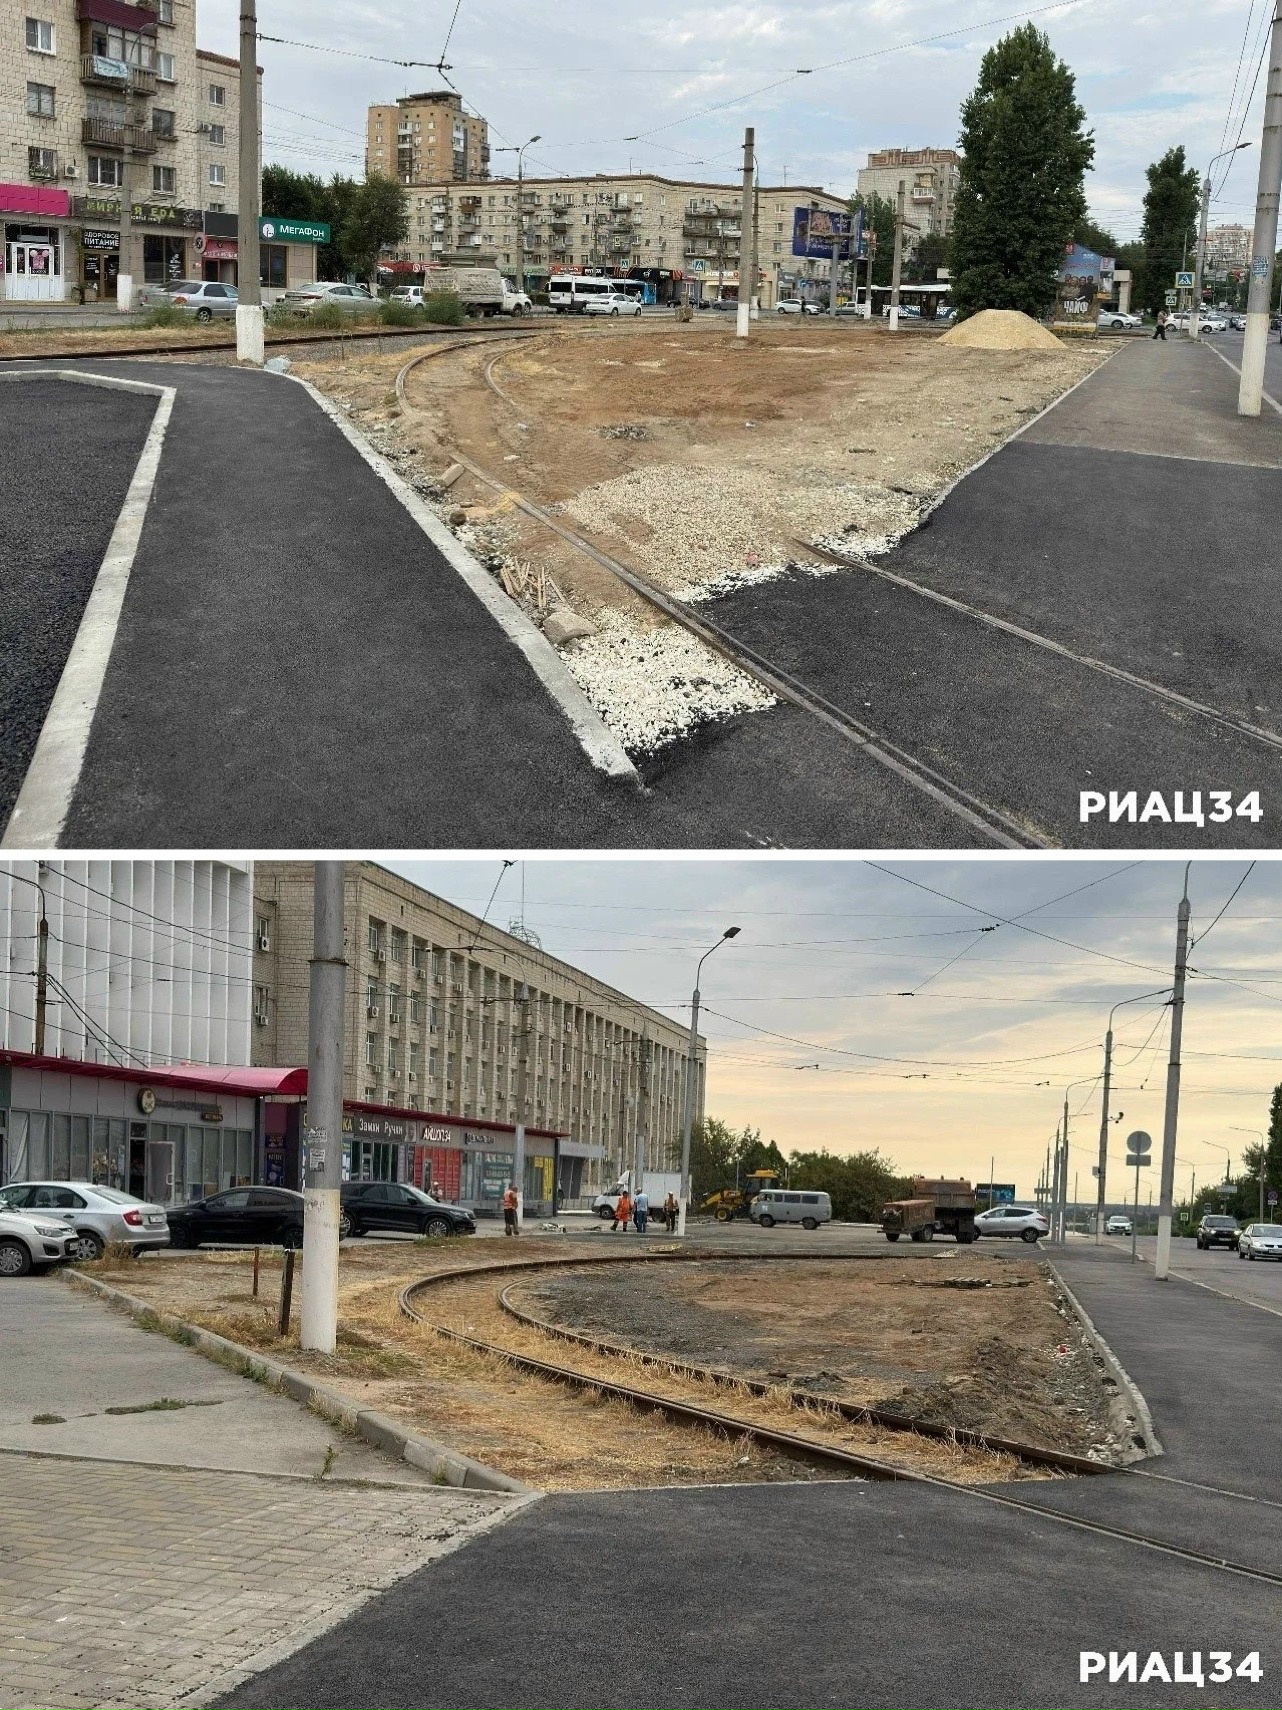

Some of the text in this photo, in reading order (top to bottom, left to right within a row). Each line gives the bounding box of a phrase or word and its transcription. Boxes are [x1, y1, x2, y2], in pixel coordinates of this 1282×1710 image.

[84, 238, 120, 247] ПИТАНИЕ
[359, 1118, 403, 1137] Замки Ручки
